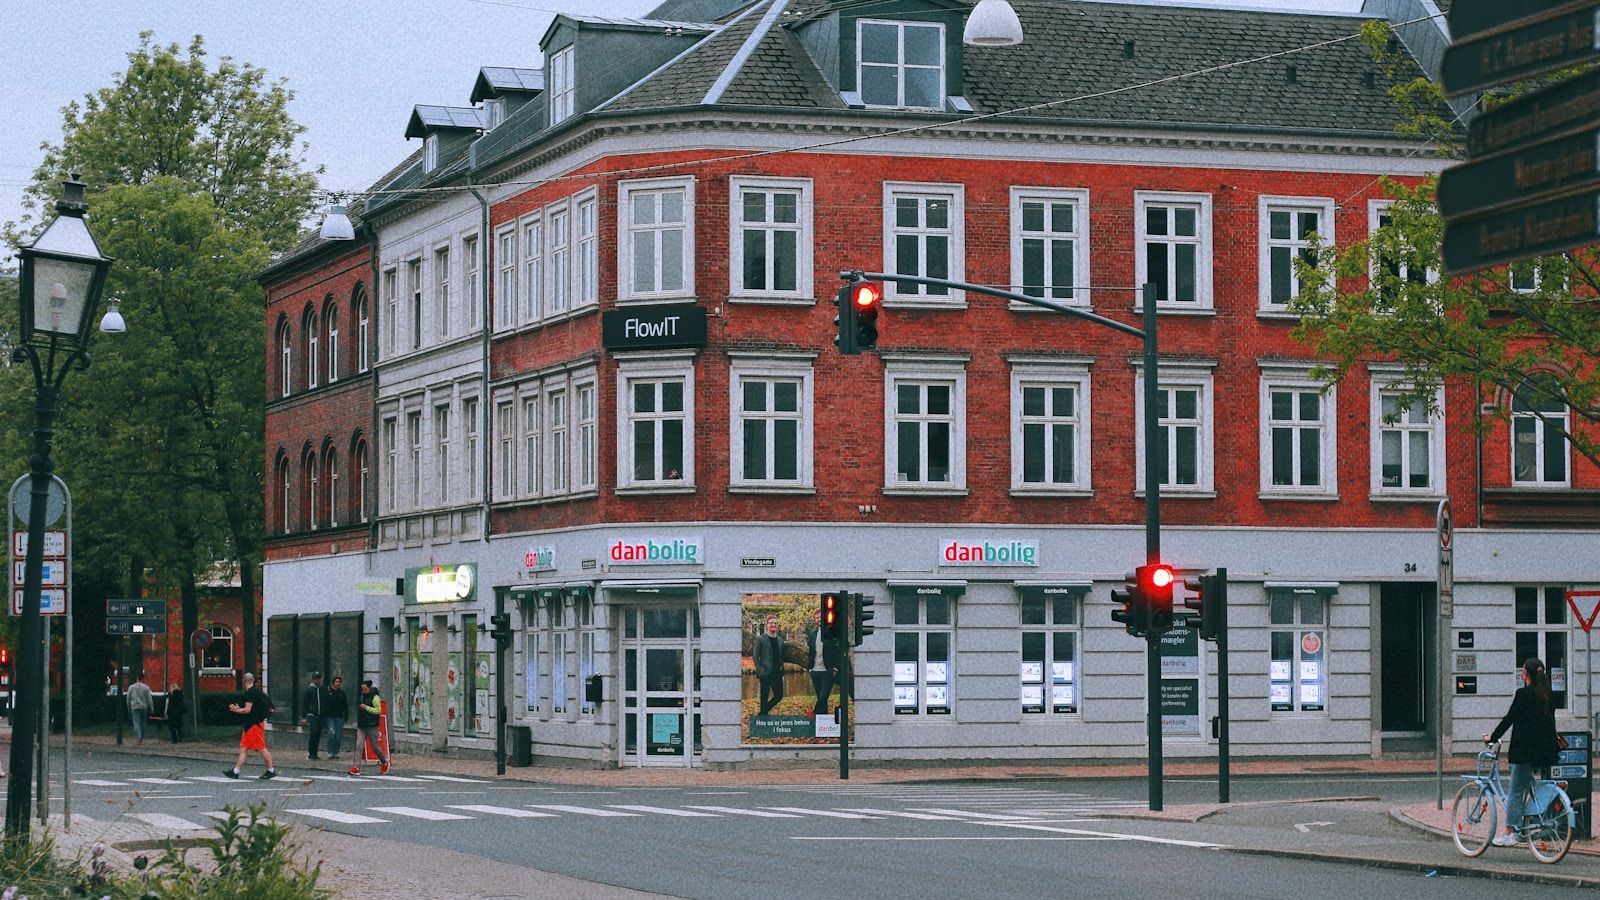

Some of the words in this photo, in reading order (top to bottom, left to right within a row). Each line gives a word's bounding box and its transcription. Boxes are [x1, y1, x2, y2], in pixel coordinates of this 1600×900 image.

[625, 316, 680, 338] FlowIT
[611, 540, 697, 563] danbolig
[945, 542, 1036, 564] danbolig
[1404, 563, 1417, 573] 34
